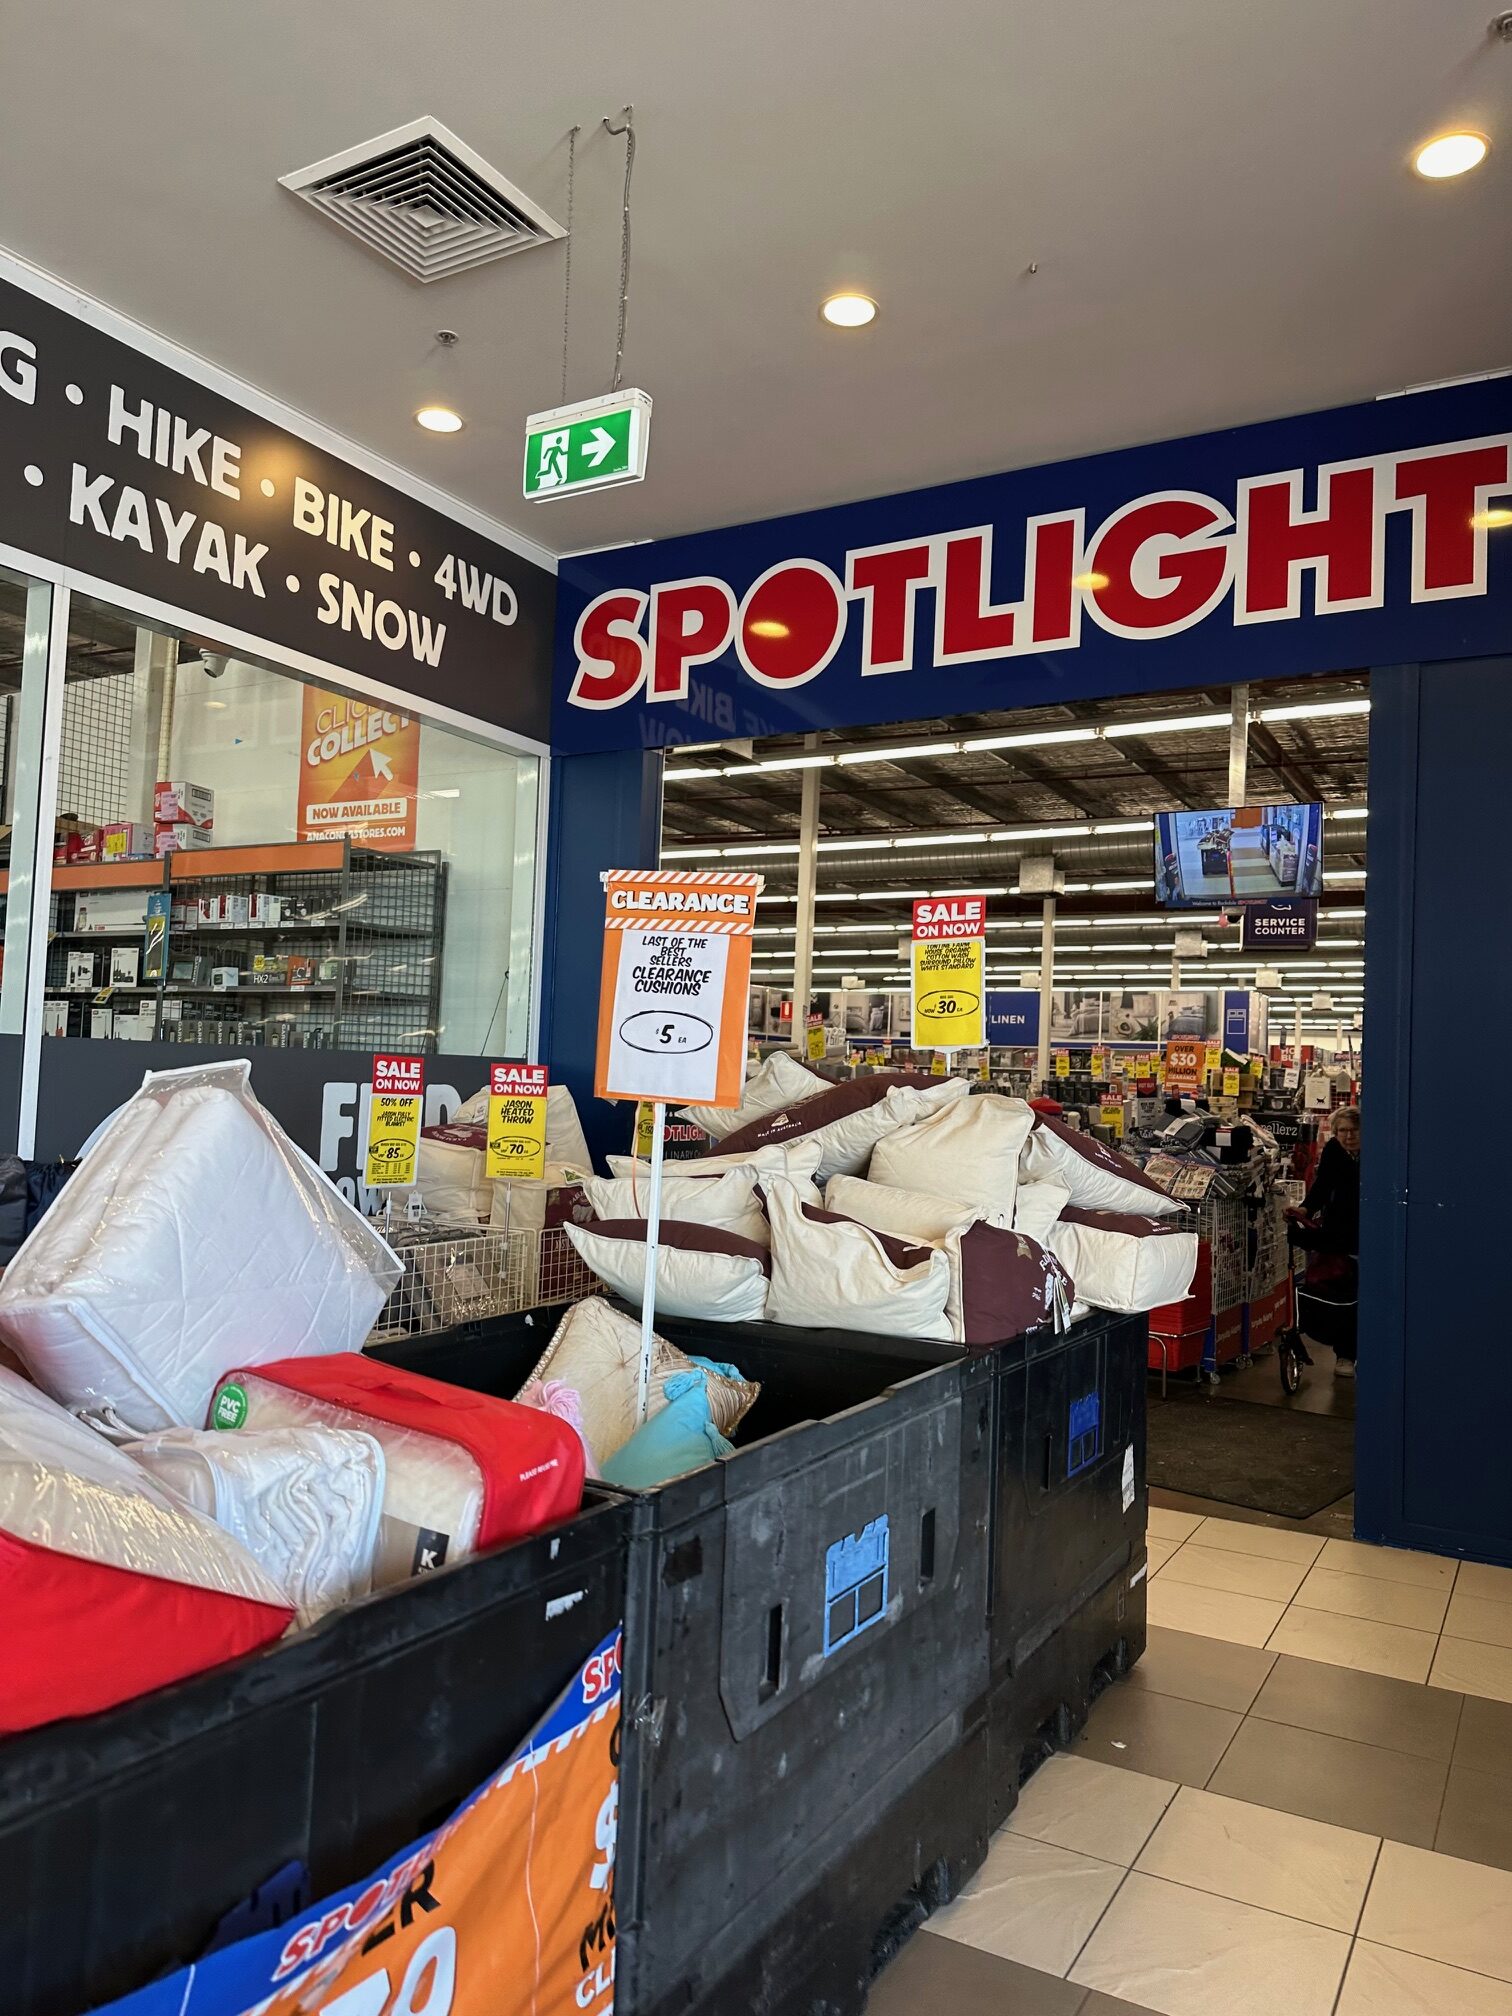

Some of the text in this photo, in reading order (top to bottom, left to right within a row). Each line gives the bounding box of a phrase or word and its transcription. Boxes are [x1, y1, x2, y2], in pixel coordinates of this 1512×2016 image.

[108, 384, 241, 501] HIKE
[292, 477, 395, 572] BIKE
[433, 553, 519, 627] 4WD
[69, 462, 447, 668] KAYAK SNOW
[568, 433, 1512, 710] SPOTLIGHT
[313, 802, 401, 820] NOW AVAILABLE
[611, 890, 750, 915] CLEARANCE
[916, 901, 982, 923] SALE
[1255, 918, 1306, 926] SERVICE
[916, 922, 980, 938] ON NOW
[1255, 927, 1306, 935] COUNTER
[642, 936, 708, 948] LAST OF THE
[660, 947, 687, 957] BEST
[650, 956, 692, 968] SELLERS
[632, 966, 712, 983] CLEARANCE
[635, 979, 701, 996] CUSHIONS
[992, 1015, 1025, 1024] LINEN
[1170, 1053, 1197, 1066] $30
[376, 1061, 421, 1078] SALE
[494, 1068, 544, 1084] SALE
[1168, 1068, 1198, 1076] MILLION
[376, 1079, 420, 1091] ON NOW
[494, 1084, 544, 1095] ON NOW
[380, 1098, 414, 1106] 50% OFF
[504, 1100, 532, 1108] JASON
[500, 1108, 534, 1116] HEATED
[502, 1115, 534, 1124] THROW
[220, 1395, 241, 1413] PVC
[218, 1406, 238, 1422] FREE
[421, 1548, 438, 1568] K
